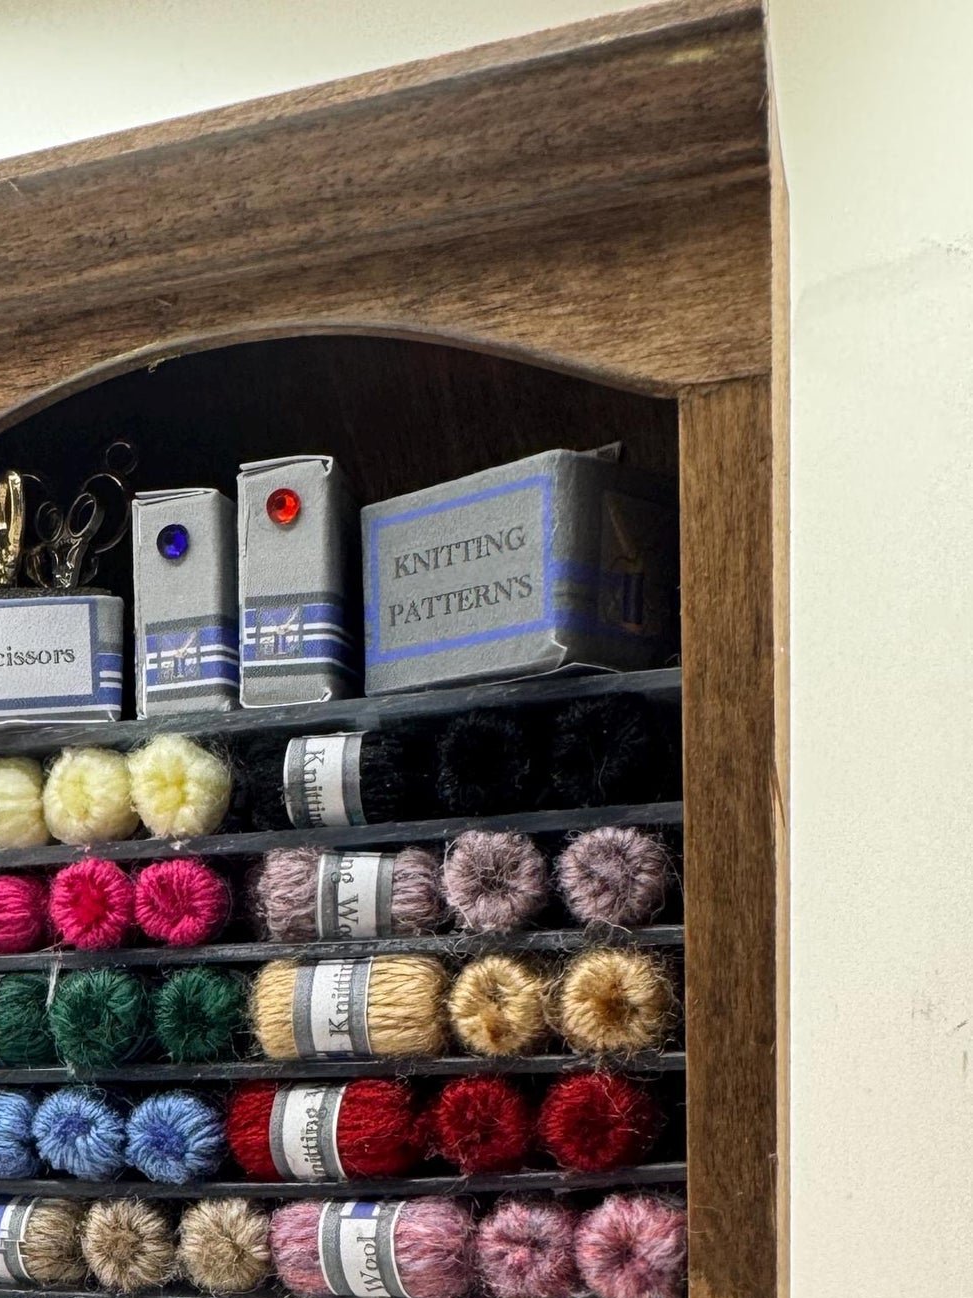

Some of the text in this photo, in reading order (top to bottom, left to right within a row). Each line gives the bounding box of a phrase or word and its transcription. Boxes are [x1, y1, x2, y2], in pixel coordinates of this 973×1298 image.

[393, 526, 526, 580] KNITTING
[388, 574, 533, 627] PATTERN'S
[328, 962, 352, 1037] Knittin
[301, 1107, 327, 1177] nitting
[356, 1235, 386, 1293] Wool
